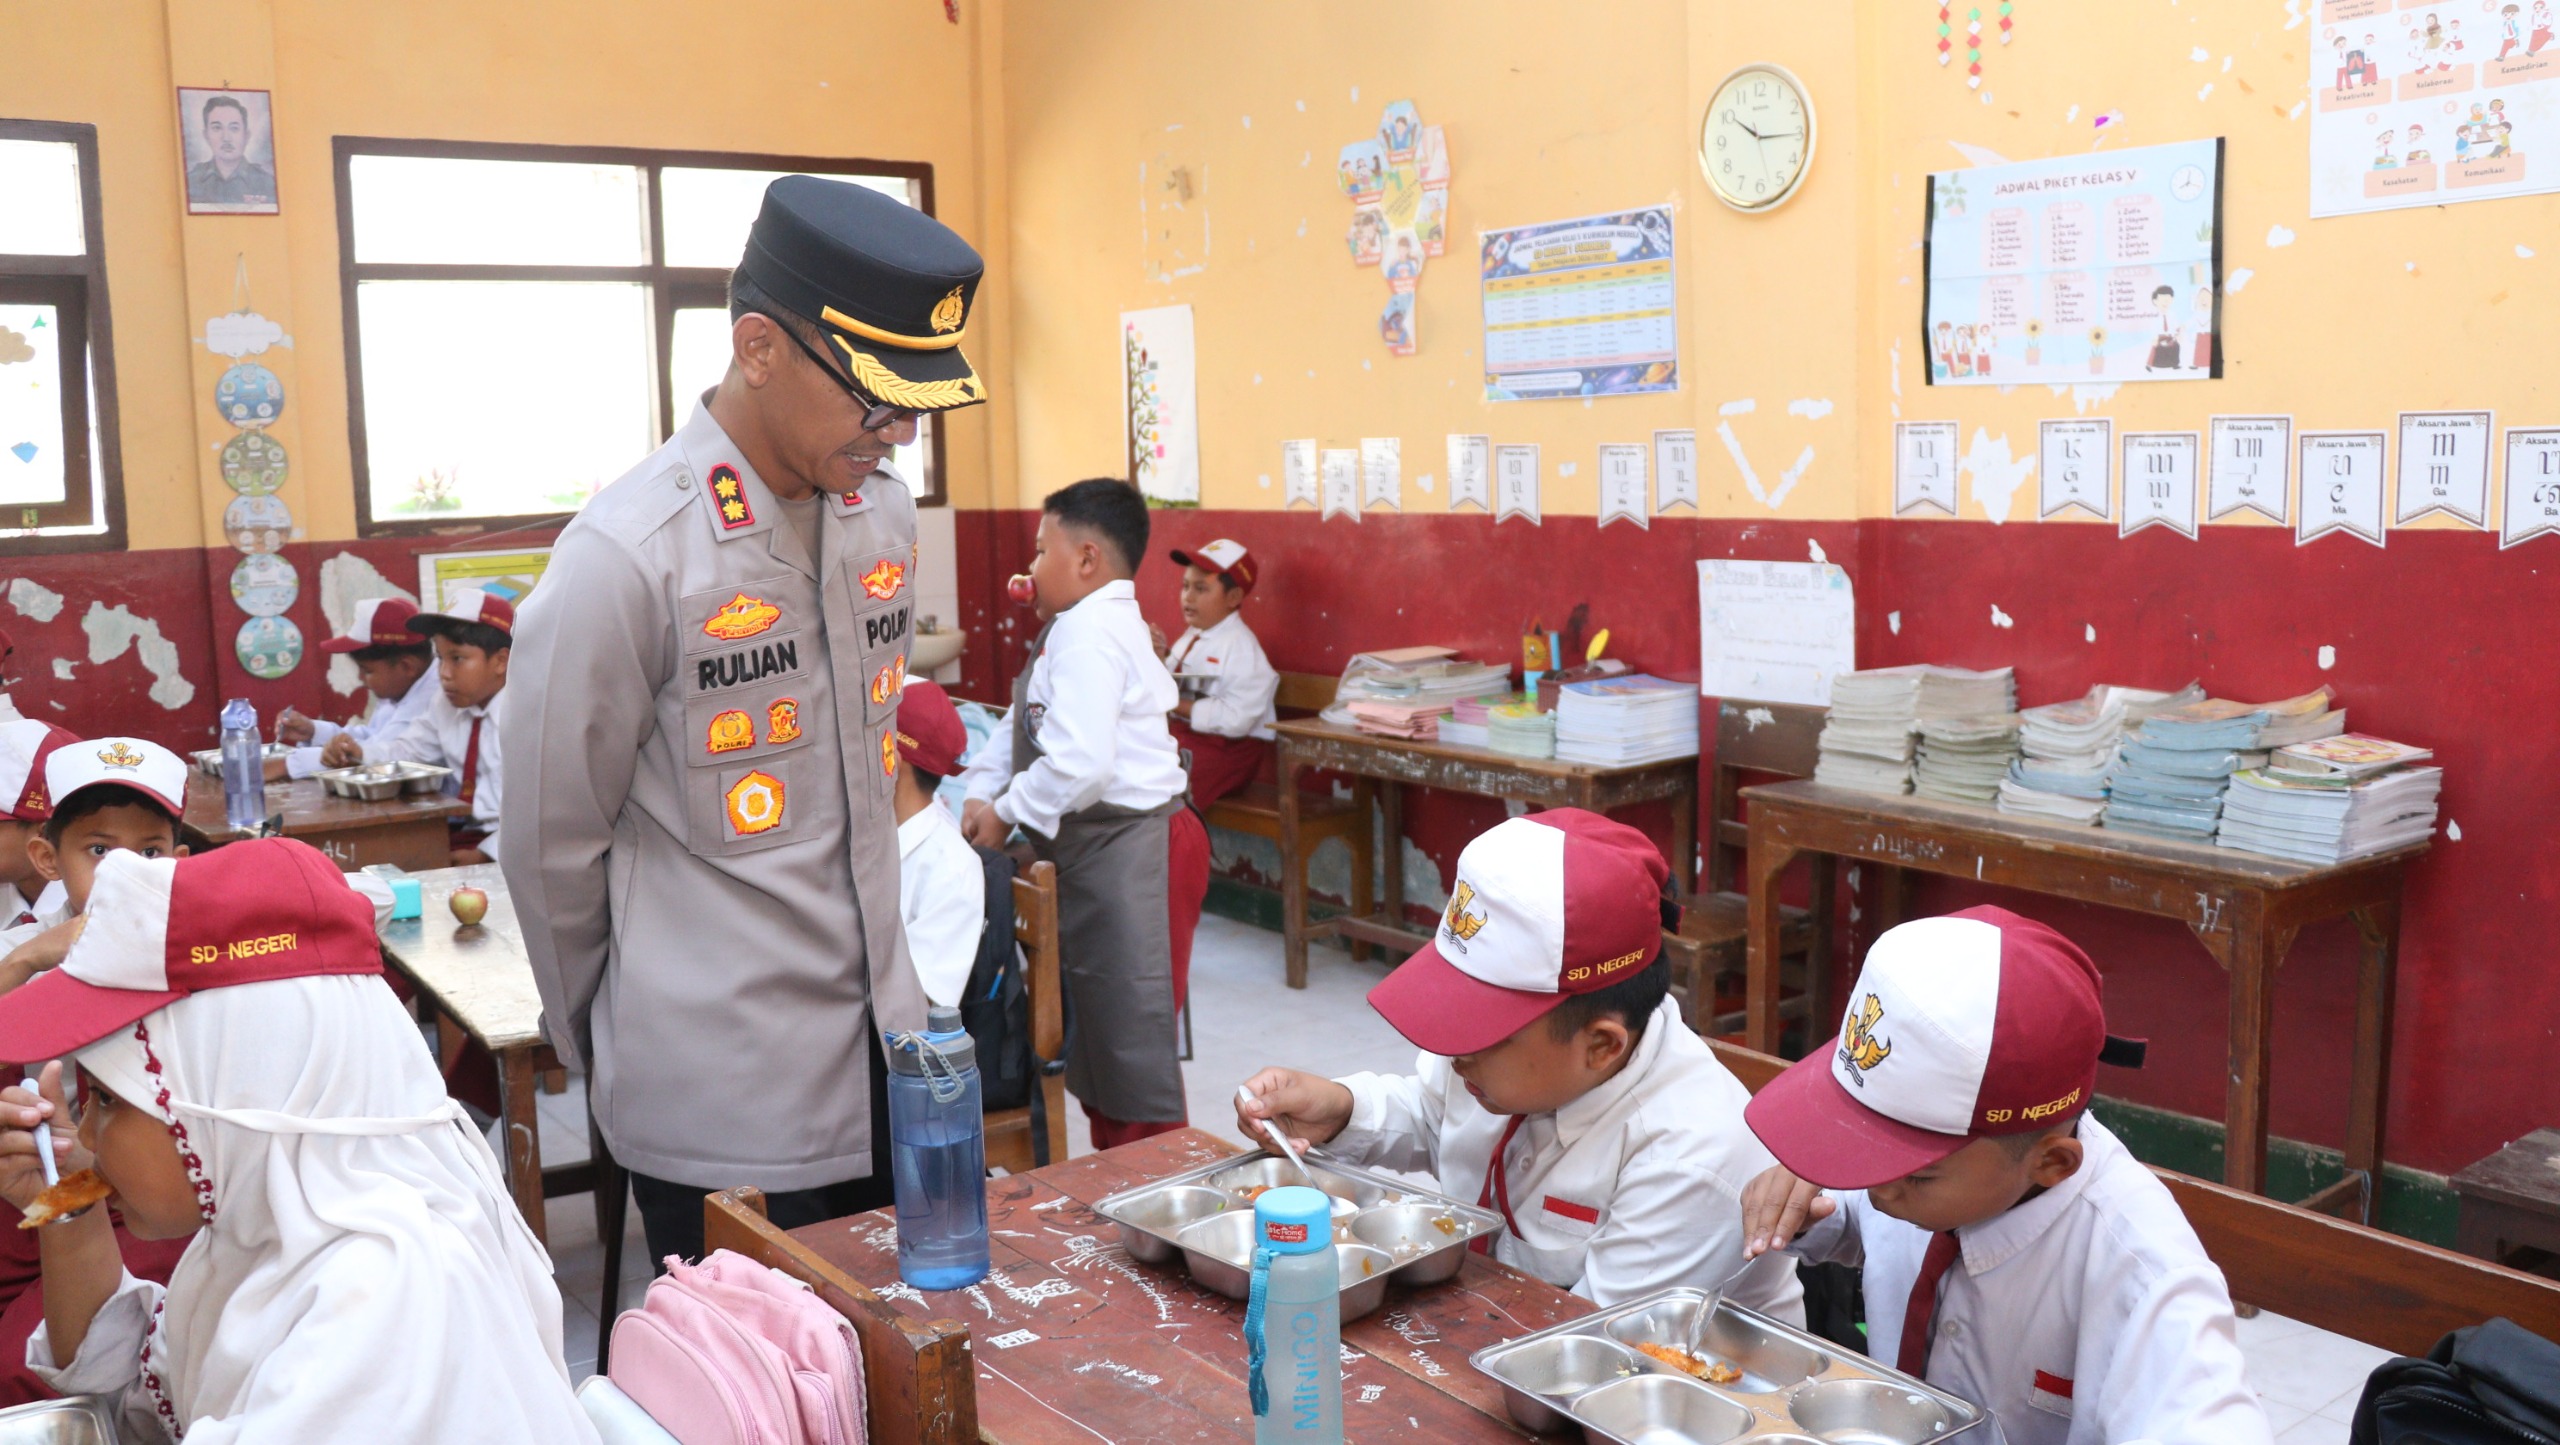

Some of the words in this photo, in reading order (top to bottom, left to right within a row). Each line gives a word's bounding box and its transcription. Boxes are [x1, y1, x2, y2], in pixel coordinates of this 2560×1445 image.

[2501, 60, 2548, 75] Kemandirian
[1754, 81, 1767, 97] 12
[2416, 77, 2454, 90] Kolaborasi
[1735, 89, 1746, 106] 11
[2335, 90, 2374, 102] Kreativitas
[1790, 99, 1799, 115] 2
[1721, 108, 1735, 126] 10
[1717, 135, 1727, 151] 9
[1723, 158, 1732, 174] 8
[1788, 151, 1798, 165] 4
[1776, 170, 1785, 186] 5
[2463, 166, 2505, 178] Komunikasi
[1737, 175, 1746, 191] 7
[1755, 179, 1766, 194] 6
[1994, 180, 2040, 196] JADWAL
[2044, 176, 2078, 190] PIKET
[2081, 171, 2122, 186] KELAS
[2127, 169, 2137, 181] V
[2382, 176, 2418, 187] Kesehatan
[2417, 419, 2446, 428] Aksara
[2447, 419, 2472, 428] Jawa
[2316, 440, 2344, 448] Aksara
[2345, 440, 2367, 448] Jawa
[2525, 437, 2558, 445] Aksara
[2432, 487, 2447, 497] Ga
[2544, 507, 2559, 516] Ba
[866, 606, 909, 650] POLRI
[697, 639, 799, 691] RULIAN
[716, 740, 746, 750] POLRI
[322, 839, 356, 864] ALI
[190, 944, 219, 965] SD
[228, 932, 298, 961] NEGERI
[1567, 966, 1592, 981] SD
[1596, 947, 1646, 976] NEGERI
[1985, 1109, 2014, 1123] SD
[2021, 1087, 2081, 1121] NEGERI
